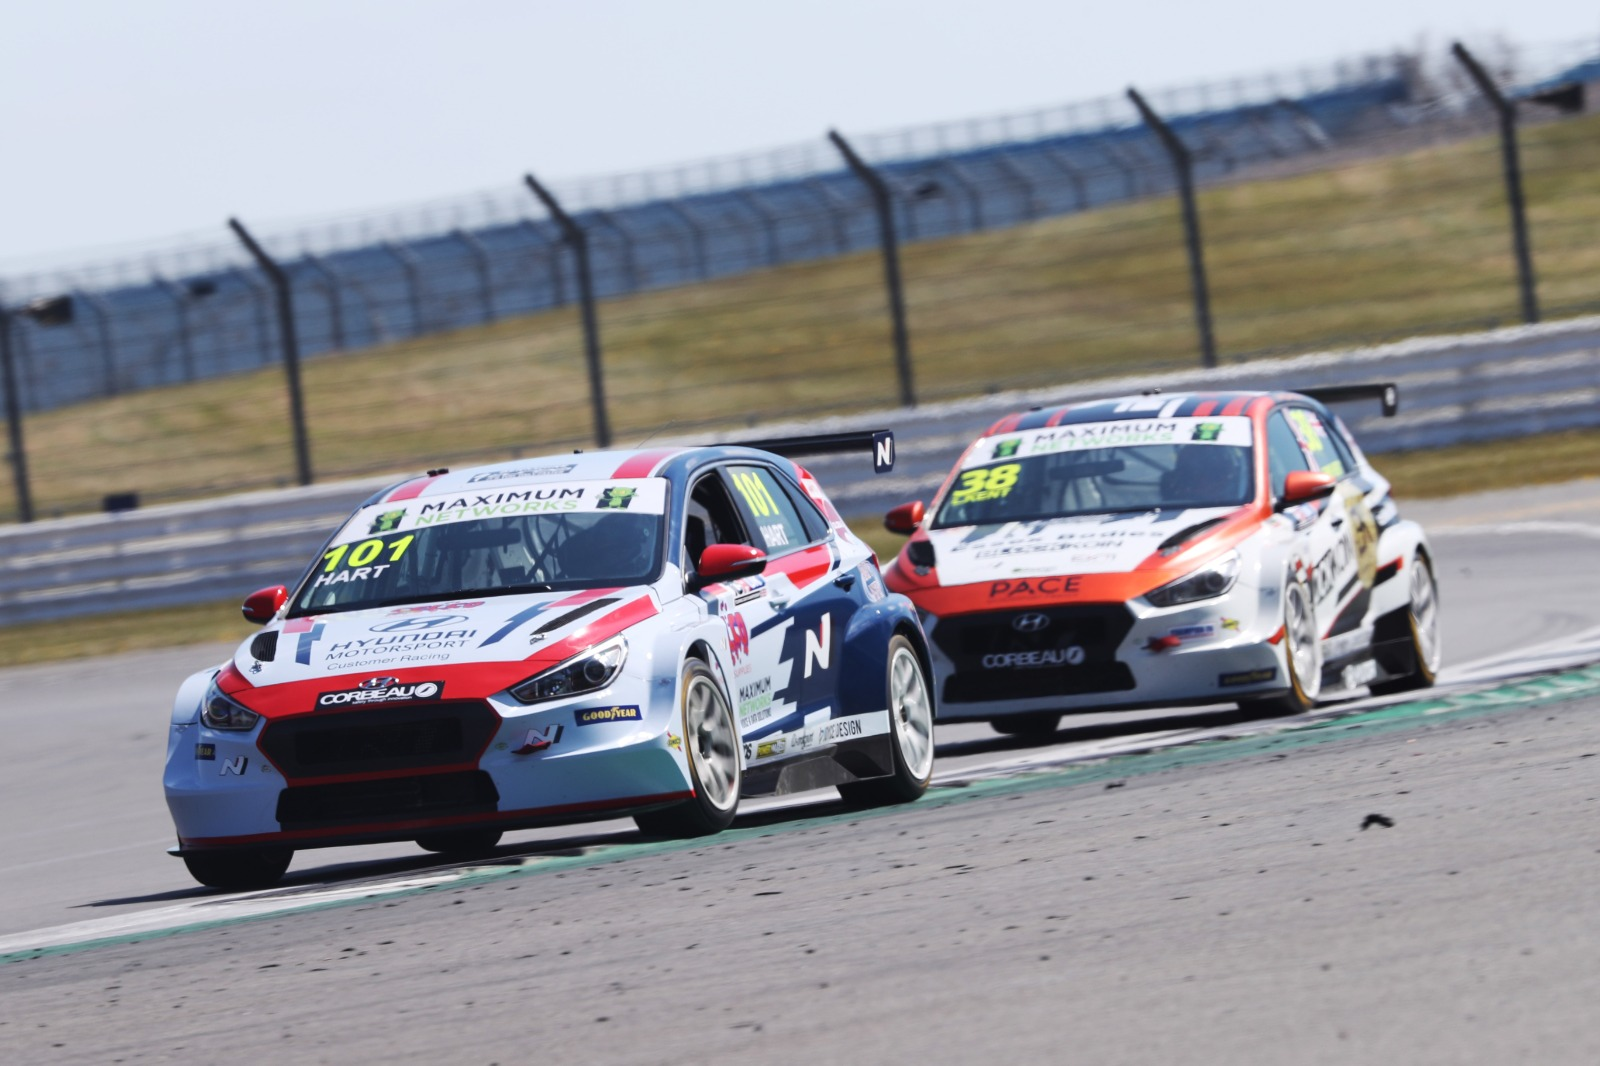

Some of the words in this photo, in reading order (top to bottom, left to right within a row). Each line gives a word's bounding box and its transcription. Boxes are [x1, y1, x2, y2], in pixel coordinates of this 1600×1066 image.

[1029, 433, 1173, 452] NETWORKS
[1034, 423, 1177, 443] MAXIMUM
[953, 463, 1022, 496] 38
[420, 488, 585, 515] MAXIMUM
[732, 472, 779, 517] 101
[414, 500, 577, 526] NETWORKS
[760, 524, 789, 547] HART
[324, 534, 414, 572] 101
[314, 564, 390, 587] HART
[990, 575, 1081, 597] PACE
[325, 639, 472, 661] MOTORSPORT
[329, 629, 478, 651] HYUNDAI
[326, 657, 397, 671] Customer
[400, 652, 450, 662] Racing
[982, 649, 1065, 668] CORBEAU
[320, 686, 415, 705] CORBEAU
[739, 676, 771, 703] MAXIMUM
[582, 705, 636, 721] GOODYEAR
[836, 719, 862, 738] DESIGN
